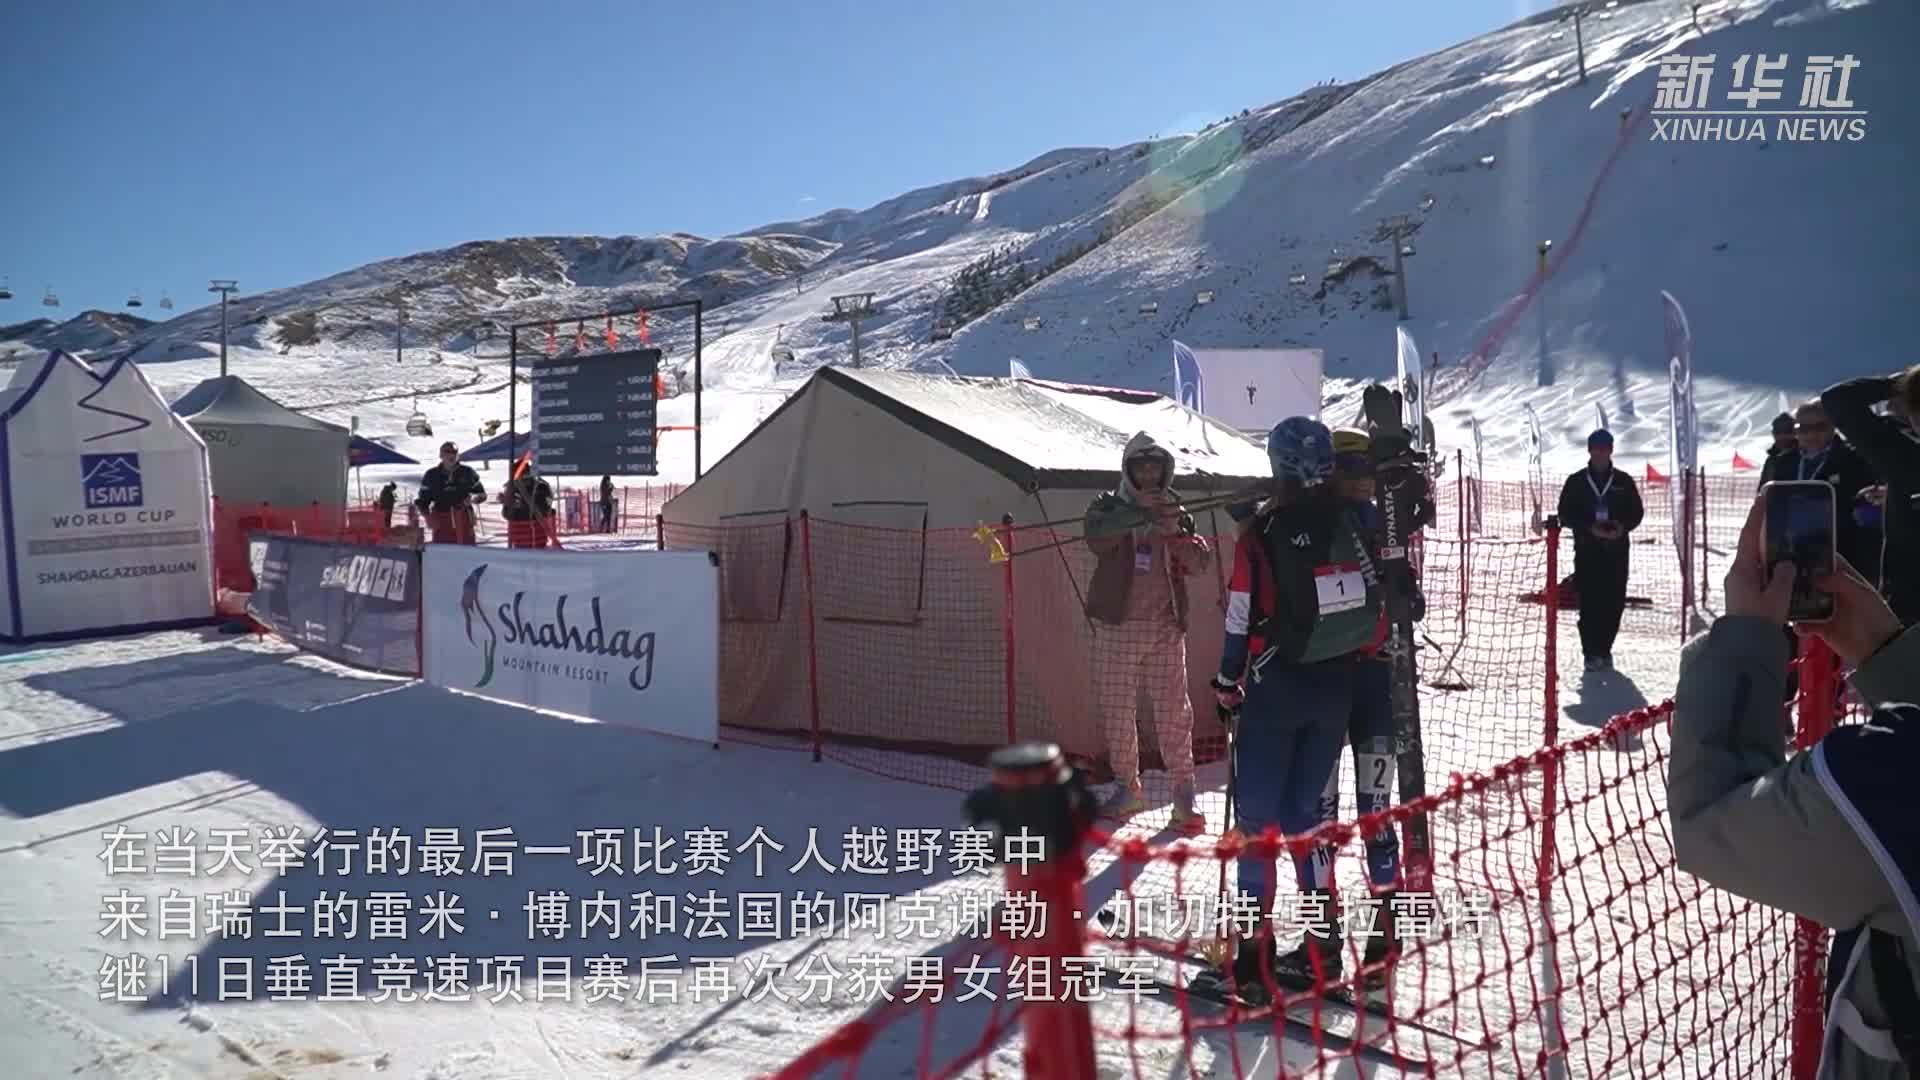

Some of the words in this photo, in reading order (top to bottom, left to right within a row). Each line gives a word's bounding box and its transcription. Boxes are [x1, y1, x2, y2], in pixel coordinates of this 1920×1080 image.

[88, 486, 140, 505] ISMF
[52, 510, 127, 529] WORLD
[137, 509, 176, 523] CUP
[1335, 579, 1345, 596] 1
[498, 591, 656, 691] Shahdag
[502, 655, 560, 678] MOUNTAIN
[565, 665, 609, 685] RESORT
[1373, 758, 1388, 789] 2
